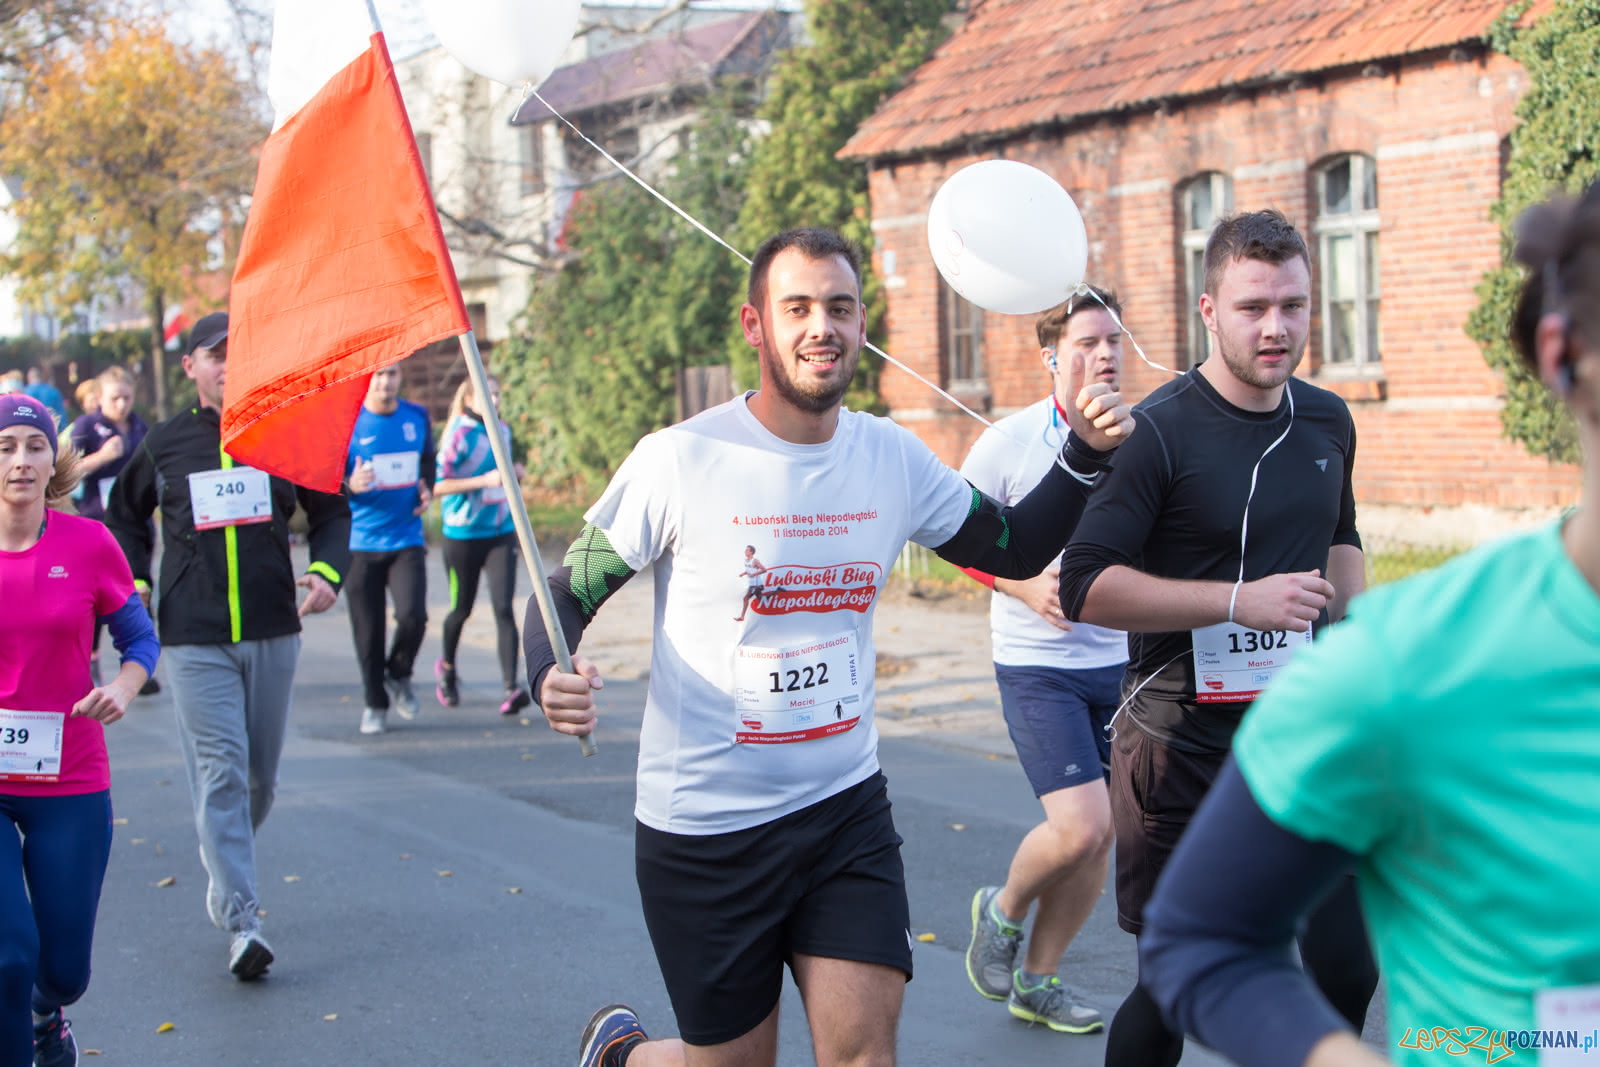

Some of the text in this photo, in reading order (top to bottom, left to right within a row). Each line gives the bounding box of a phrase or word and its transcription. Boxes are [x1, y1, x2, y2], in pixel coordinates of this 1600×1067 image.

[215, 481, 245, 496] 240
[732, 515, 742, 526] 4.
[745, 513, 789, 526] Luboński
[792, 514, 814, 526] Bieg
[783, 527, 825, 539] listopada
[828, 526, 849, 536] 2014
[764, 567, 875, 588] Luboński Bieg
[757, 588, 876, 611] Niepodległości
[785, 650, 800, 658] BIEG
[801, 636, 849, 654] NIEPODLEGŁOŚCI
[1228, 630, 1288, 654] 1302
[850, 659, 858, 686] STREFA
[1248, 659, 1274, 668] Marcin
[768, 662, 830, 693] 1222
[789, 696, 816, 708] Maciej
[0, 728, 30, 744] 39
